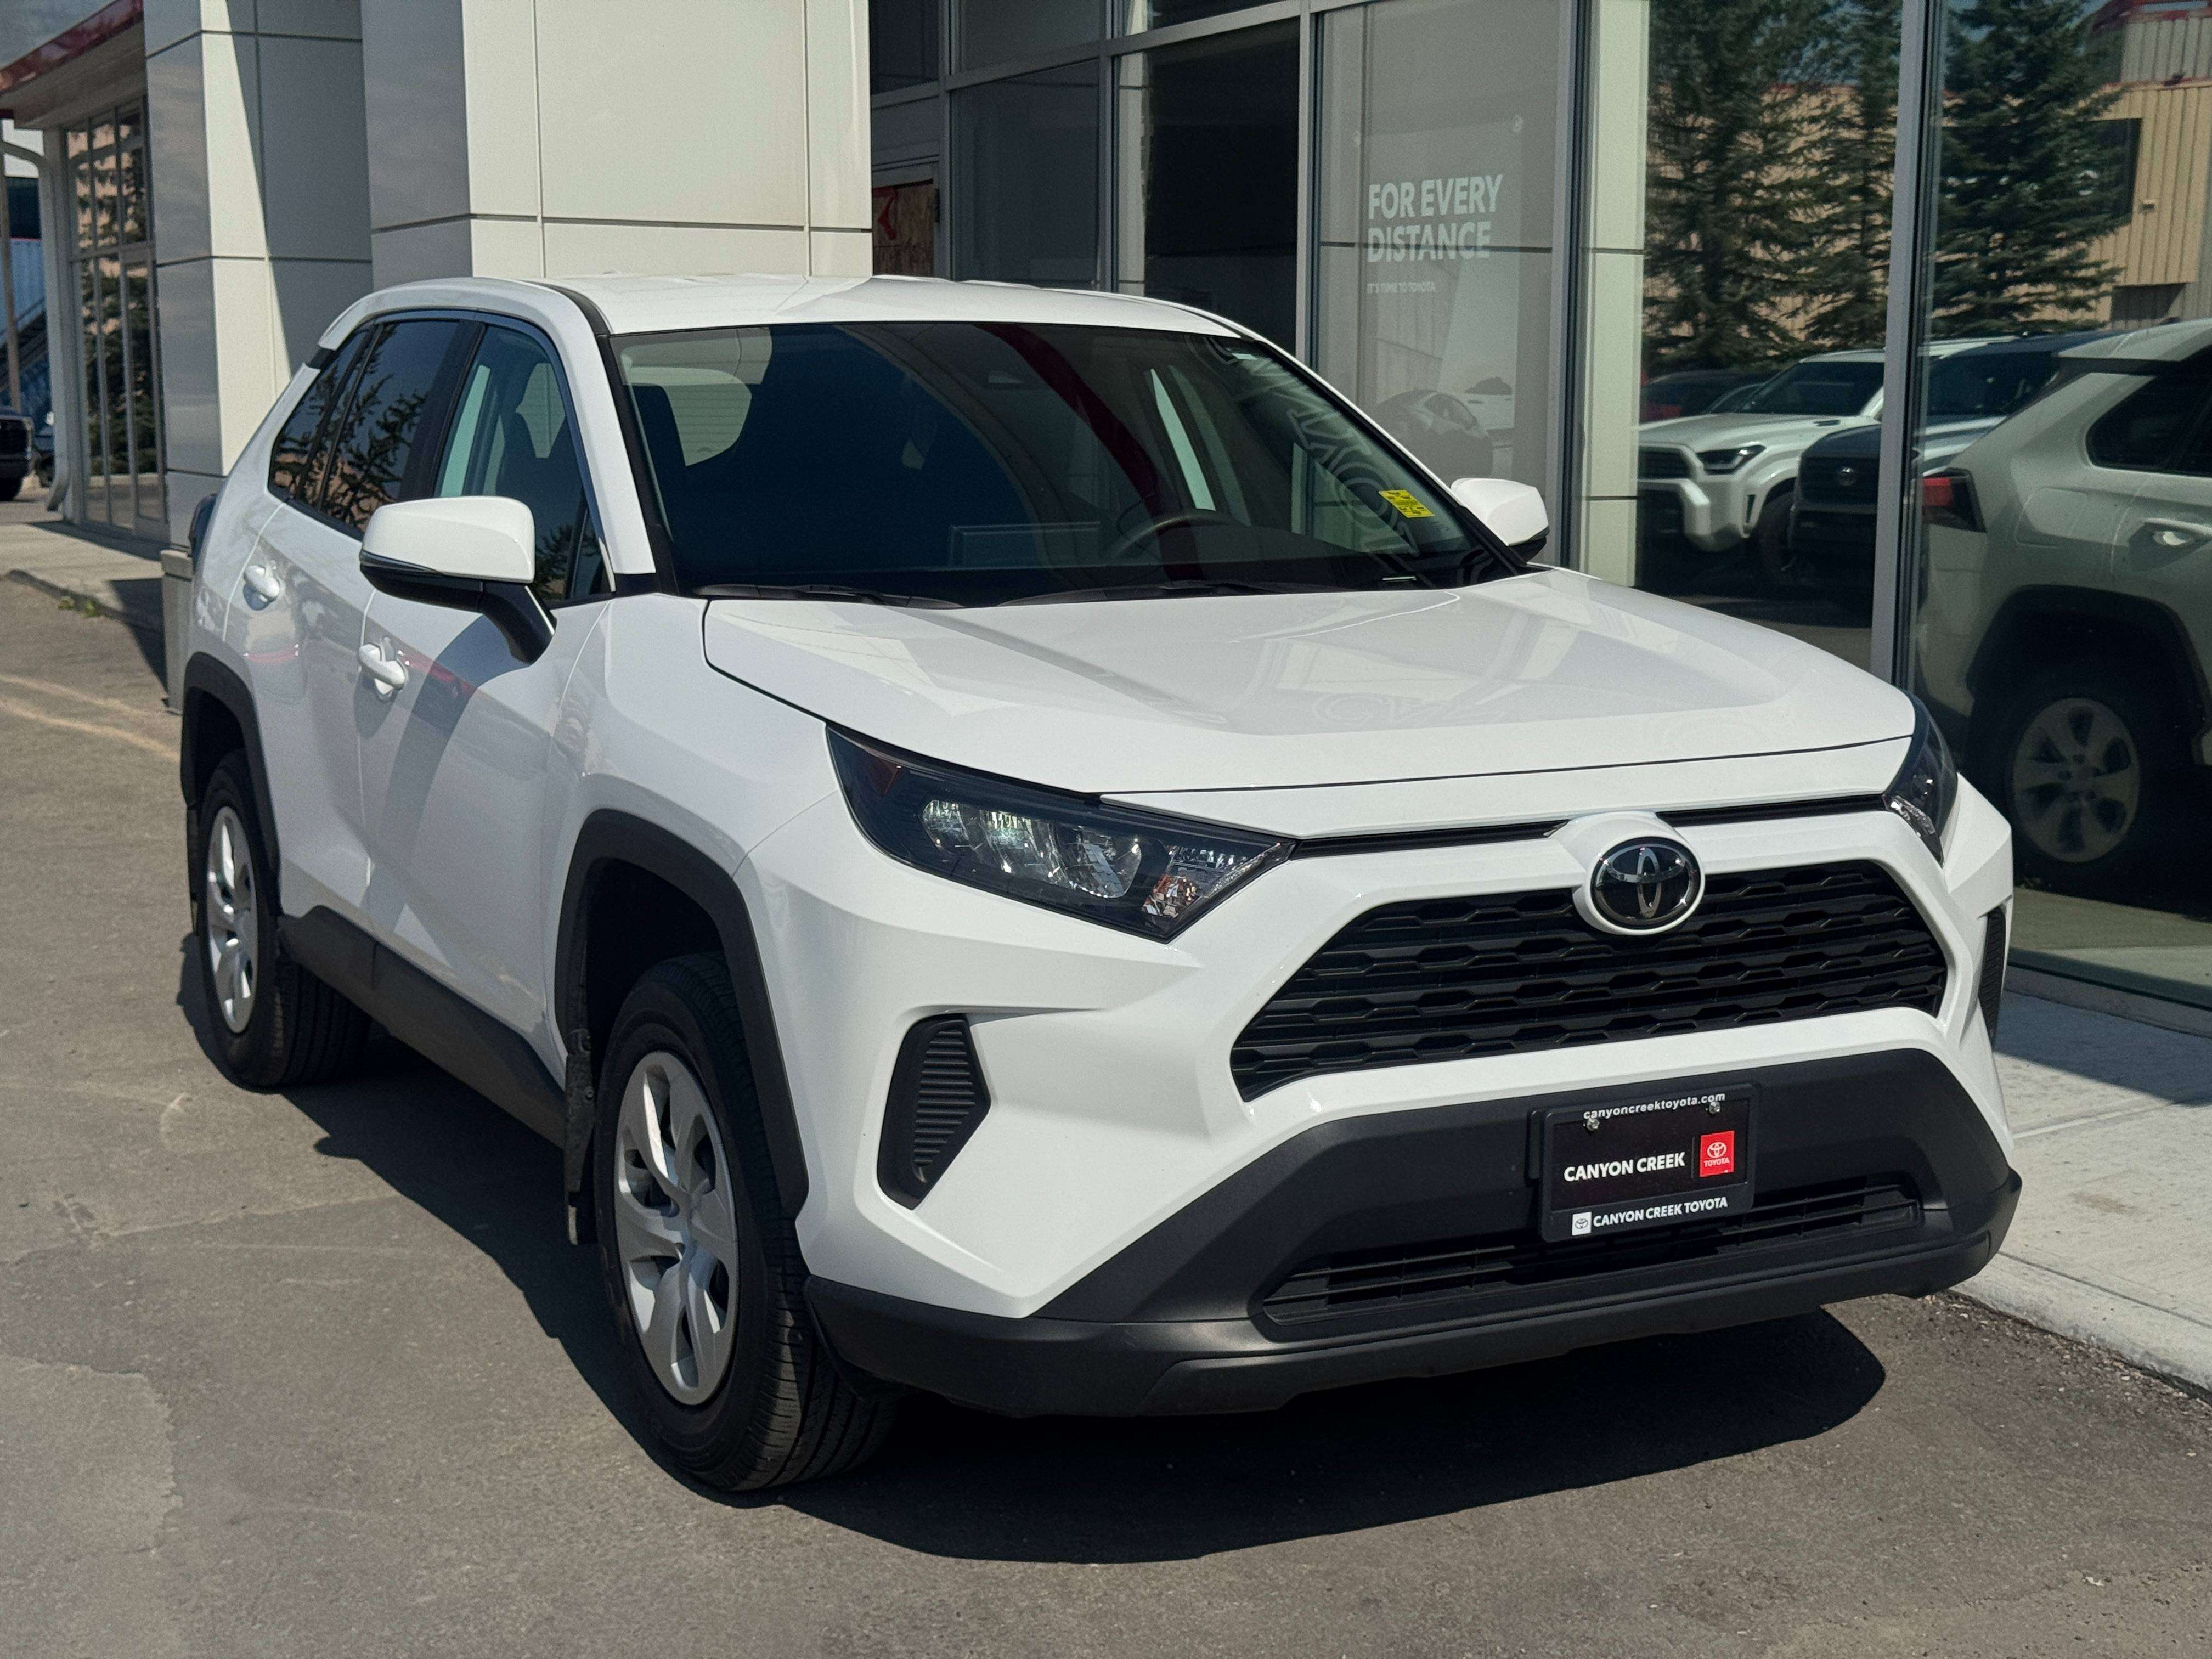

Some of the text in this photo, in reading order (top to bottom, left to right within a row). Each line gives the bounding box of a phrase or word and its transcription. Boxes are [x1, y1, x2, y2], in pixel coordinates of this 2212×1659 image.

[1369, 174, 1503, 220] FOR EVERY
[1368, 221, 1491, 262] DISTANCE
[1583, 1093, 1725, 1119] canyoncreektoyota.com
[1564, 1152, 1685, 1182] CANYON CREEK
[1703, 1157, 1730, 1167] TOYOTA
[1593, 1196, 1729, 1228] CANYON CREEK TOYOTA
